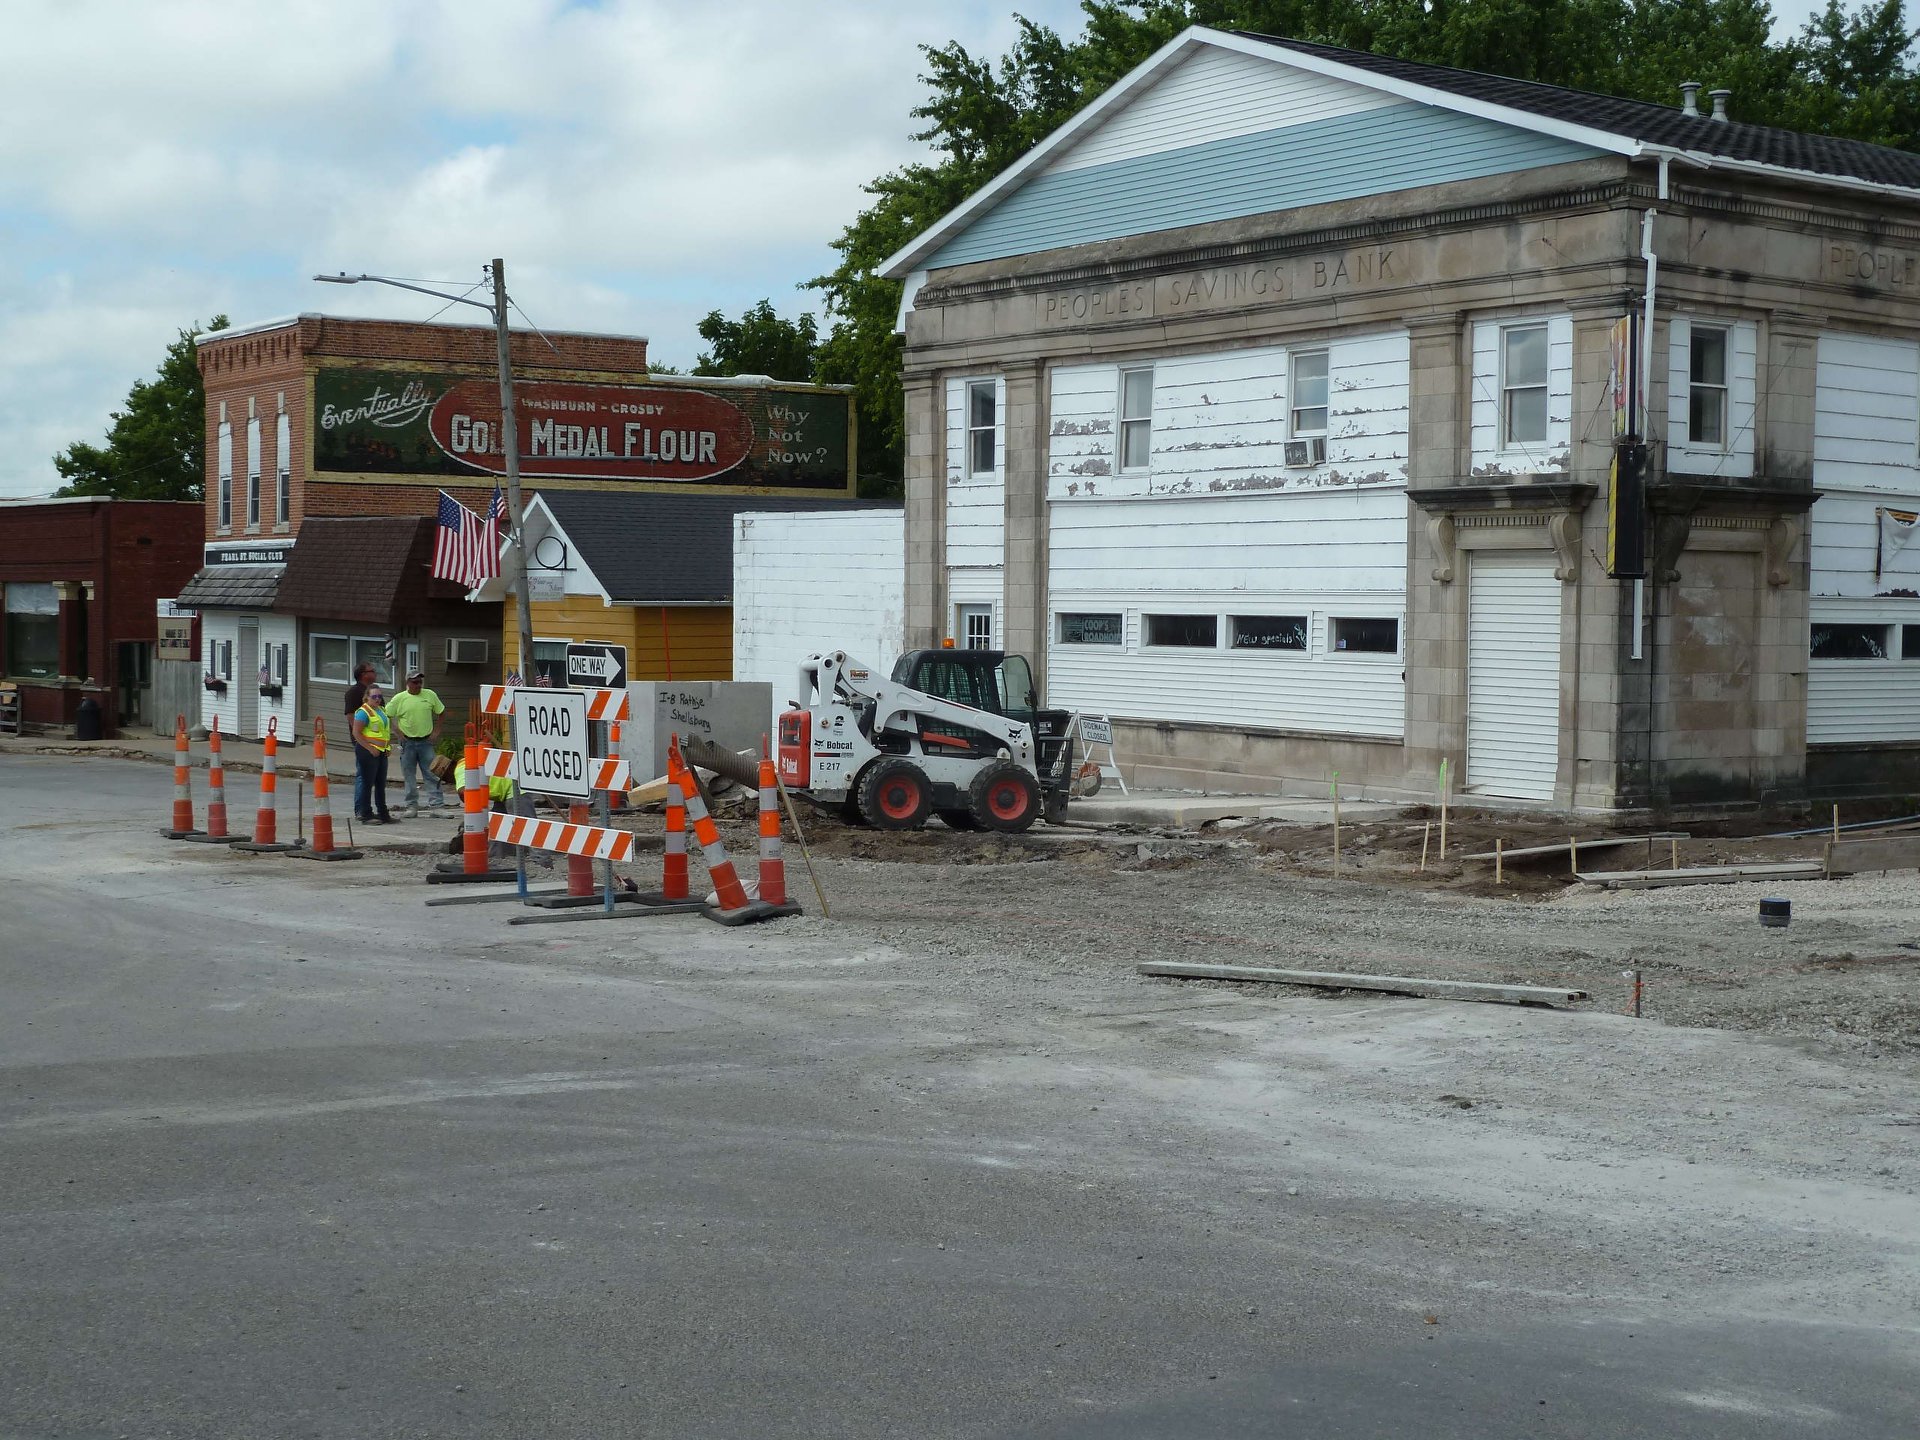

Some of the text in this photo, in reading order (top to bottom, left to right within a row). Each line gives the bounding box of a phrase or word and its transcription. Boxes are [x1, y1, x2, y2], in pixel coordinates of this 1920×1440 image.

[1044, 250, 1396, 322] PEOPLES SAVINGS BANK
[321, 380, 436, 429] Eventually
[611, 403, 664, 416] CROSBY
[766, 404, 810, 425] Why
[531, 417, 616, 457] MEDAL
[624, 422, 717, 463] FLOUR
[769, 426, 803, 442] Not
[768, 447, 828, 464] Now?
[571, 657, 606, 675] ONE WAY
[528, 705, 571, 737] ROAD
[1087, 731, 1107, 740] CLOSED
[826, 741, 853, 750] Bobcat
[523, 746, 582, 781] CLOSED
[819, 762, 841, 771] E 217
